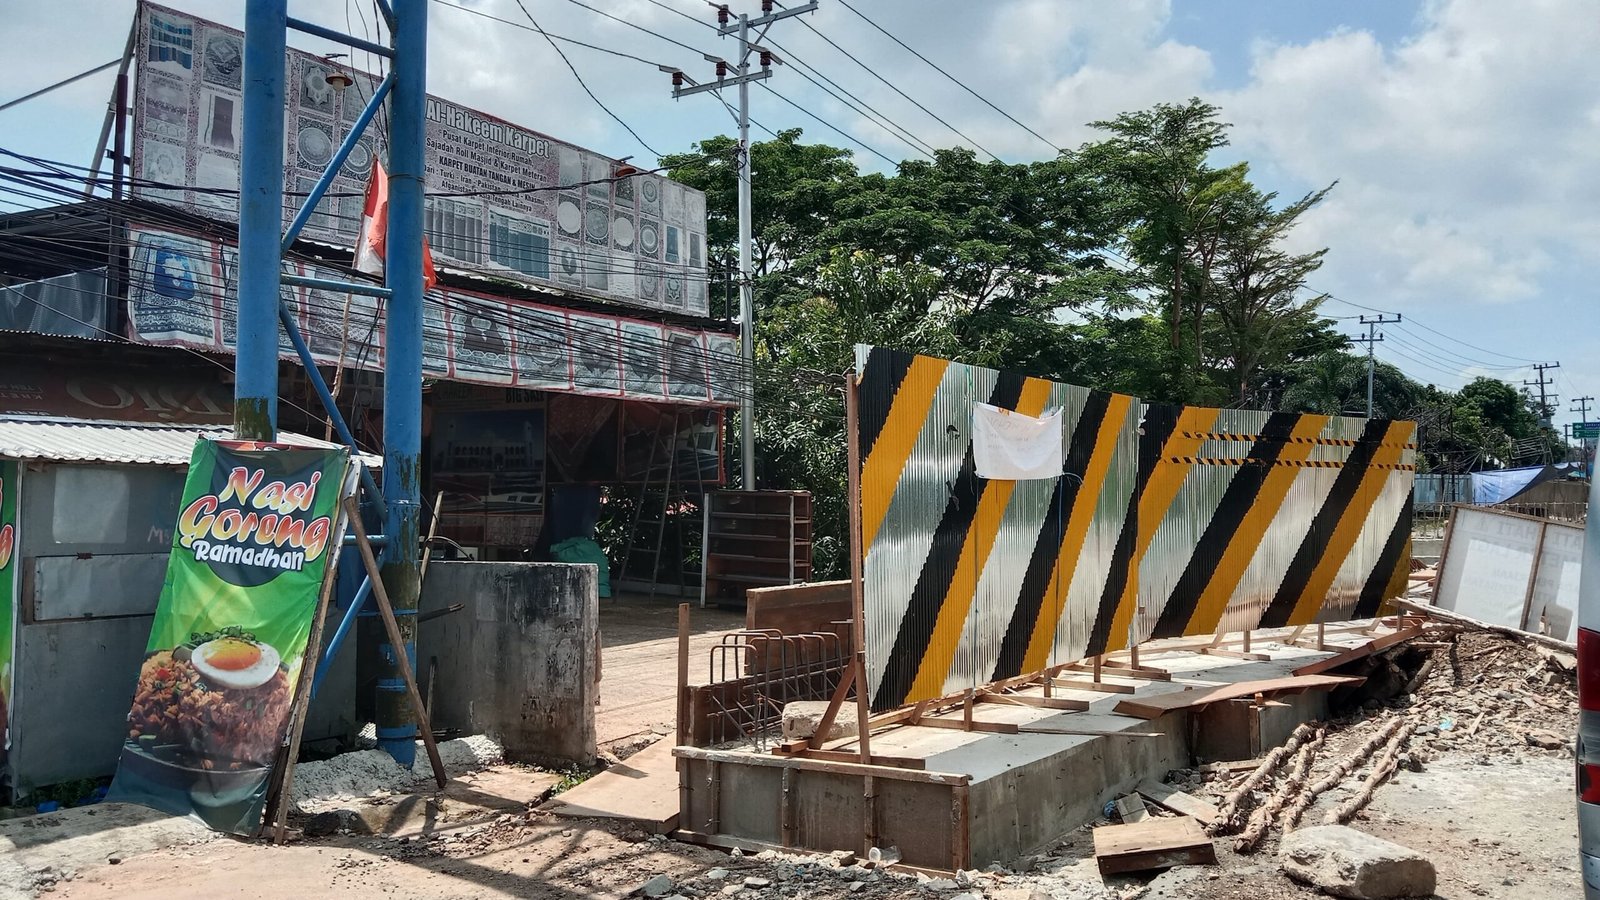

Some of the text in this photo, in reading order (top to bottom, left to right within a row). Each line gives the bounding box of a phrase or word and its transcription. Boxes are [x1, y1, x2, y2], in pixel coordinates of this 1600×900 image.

[425, 99, 549, 159] Al-Hakeem Karpet
[442, 130, 461, 143] Pusat
[464, 137, 484, 150] Karpet
[426, 138, 454, 153] Sajadah
[456, 147, 469, 158] Roll
[470, 151, 492, 165] Masjid
[500, 161, 520, 174] Karpet
[523, 168, 547, 182] Meteran
[439, 156, 463, 171] KARPET
[464, 163, 488, 178] BUATAN
[489, 170, 511, 185] TANGAN
[517, 180, 536, 190] MESIN
[440, 169, 455, 180] Turki
[460, 175, 472, 184] Iran
[492, 194, 511, 206] Tengah
[218, 466, 321, 515] Nasi
[179, 495, 330, 562] Goreng
[192, 540, 304, 570] Ramadhan
